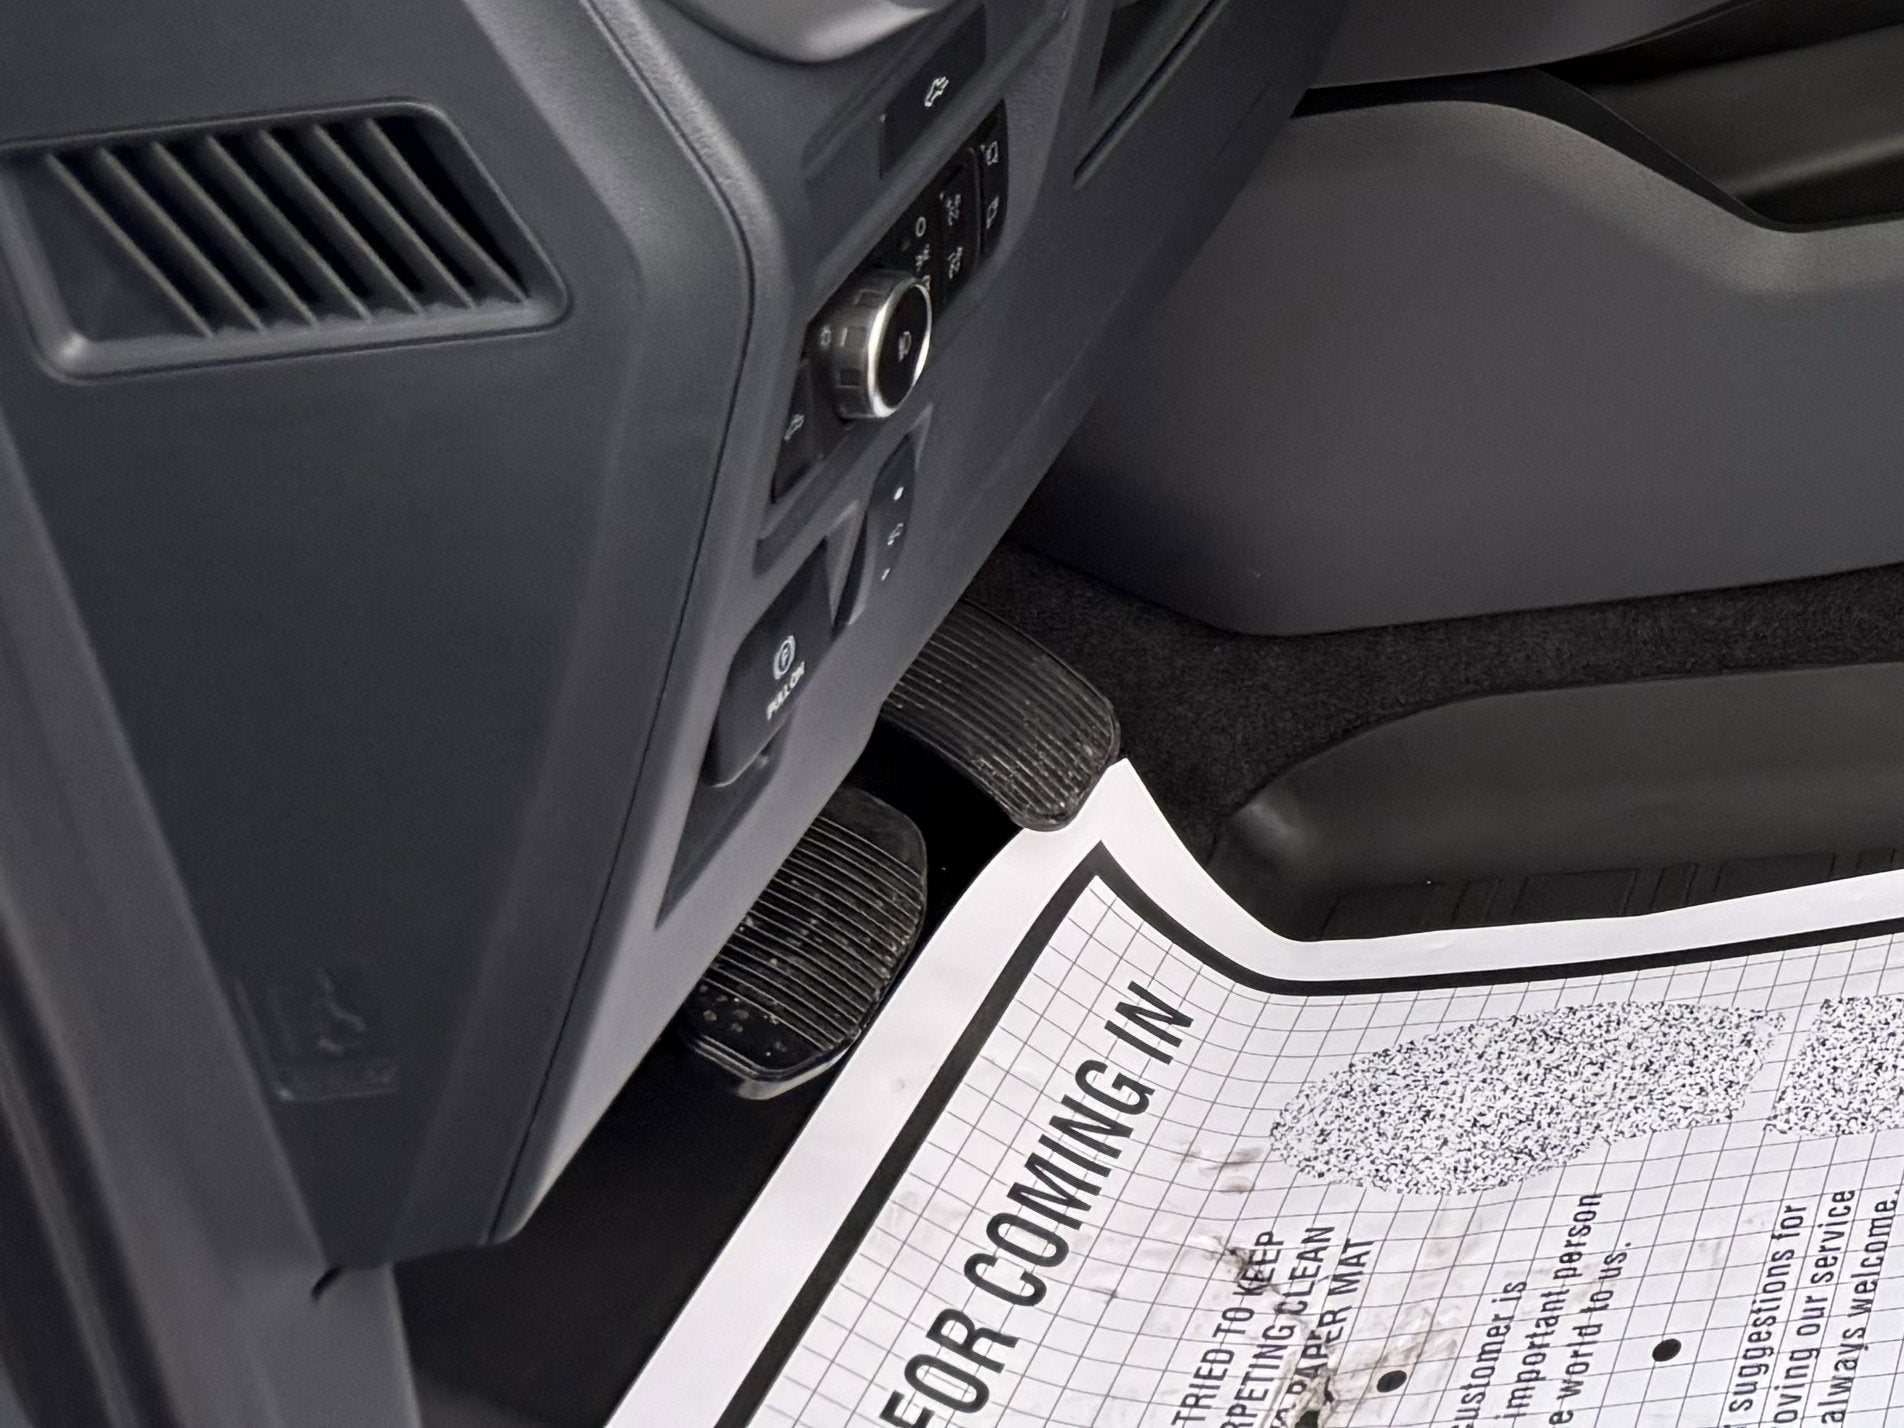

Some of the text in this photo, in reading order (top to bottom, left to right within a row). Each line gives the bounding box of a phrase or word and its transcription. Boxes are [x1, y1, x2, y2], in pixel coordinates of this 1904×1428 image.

[766, 661, 805, 721] PULL ON
[879, 980, 1194, 1428] FOR COMING IN
[1327, 1238, 1376, 1296] MAT
[1492, 1281, 1528, 1303] is
[1579, 1290, 1614, 1313] to
[1598, 1242, 1632, 1281] us.
[1171, 1231, 1285, 1426] TRIED TO KEEP
[1219, 1227, 1335, 1428] RPETING CLEAN
[1494, 1193, 1602, 1420] important person
[1556, 1323, 1603, 1400] world
[1729, 1204, 1807, 1413] suggestions for
[1773, 1190, 1855, 1424] oving our service
[1817, 1188, 1900, 1424] always welcome.
